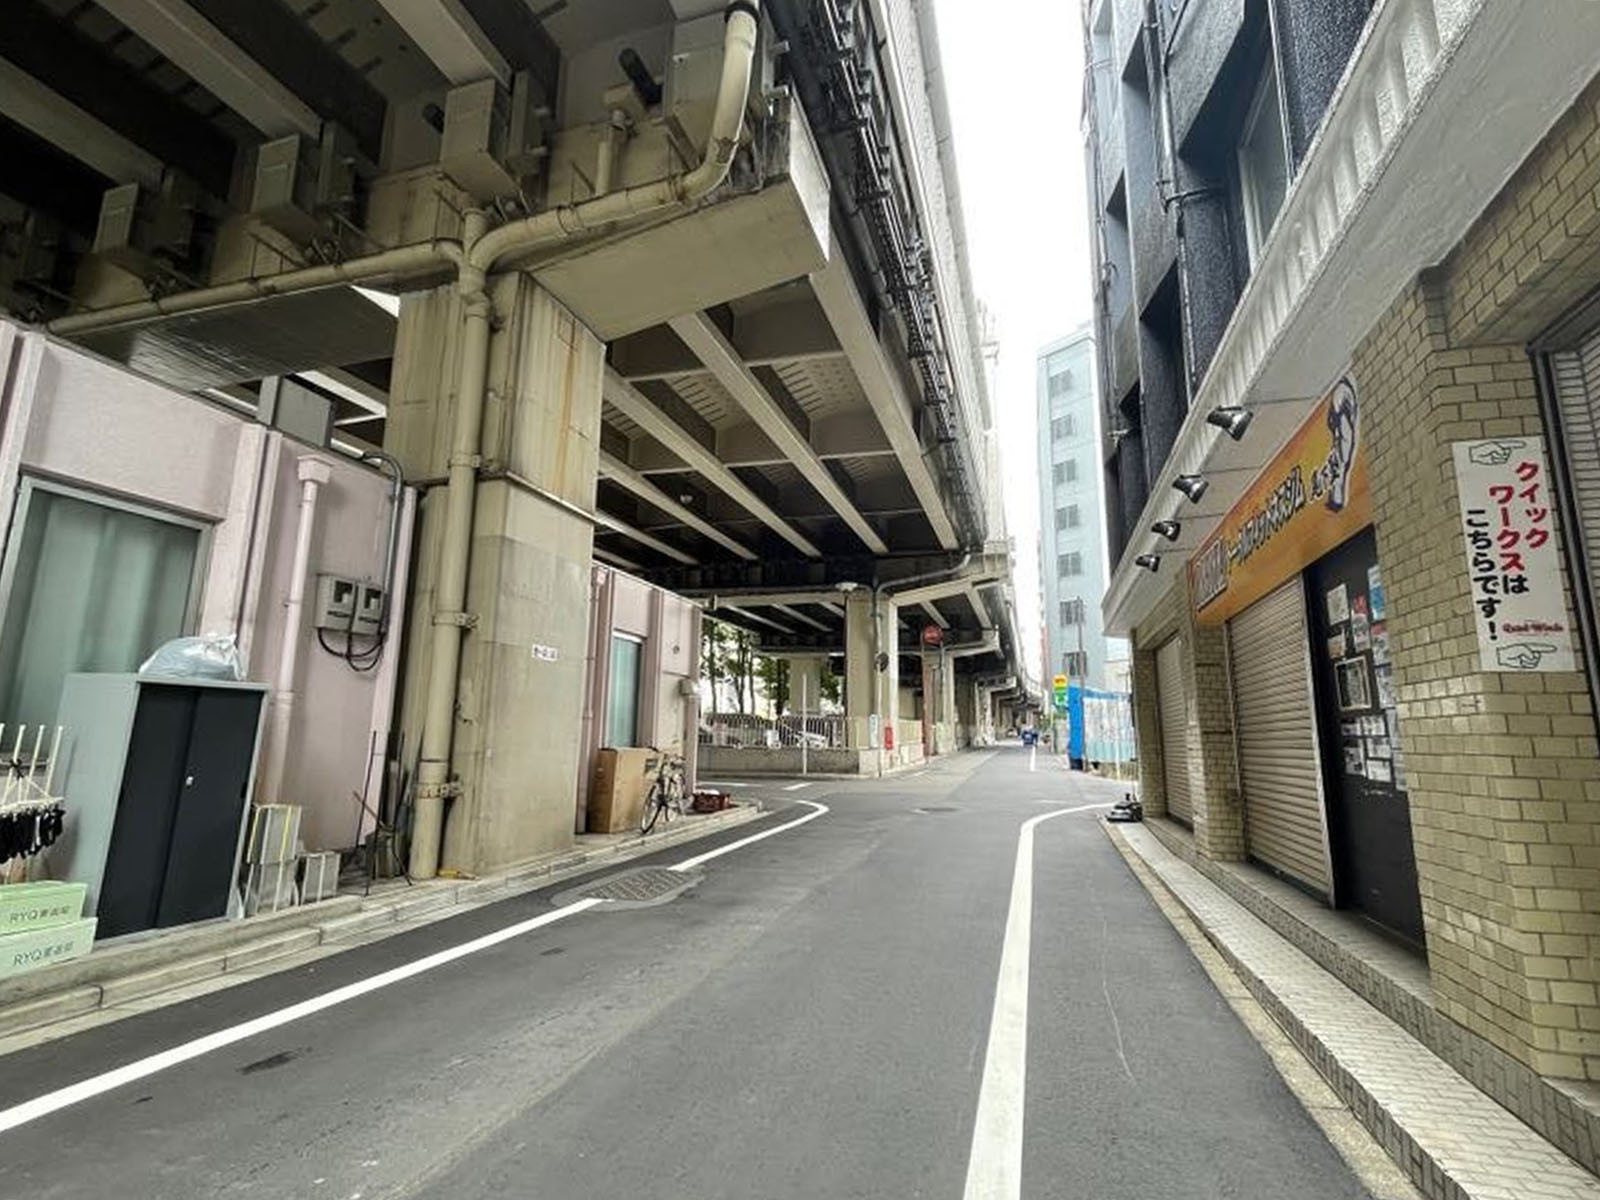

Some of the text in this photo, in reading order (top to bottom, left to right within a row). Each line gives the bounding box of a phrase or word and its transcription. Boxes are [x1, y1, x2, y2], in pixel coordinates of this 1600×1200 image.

[1489, 485, 1530, 595] ワークスは
[1516, 462, 1549, 549] クイック
[1467, 509, 1501, 641] こちらです！
